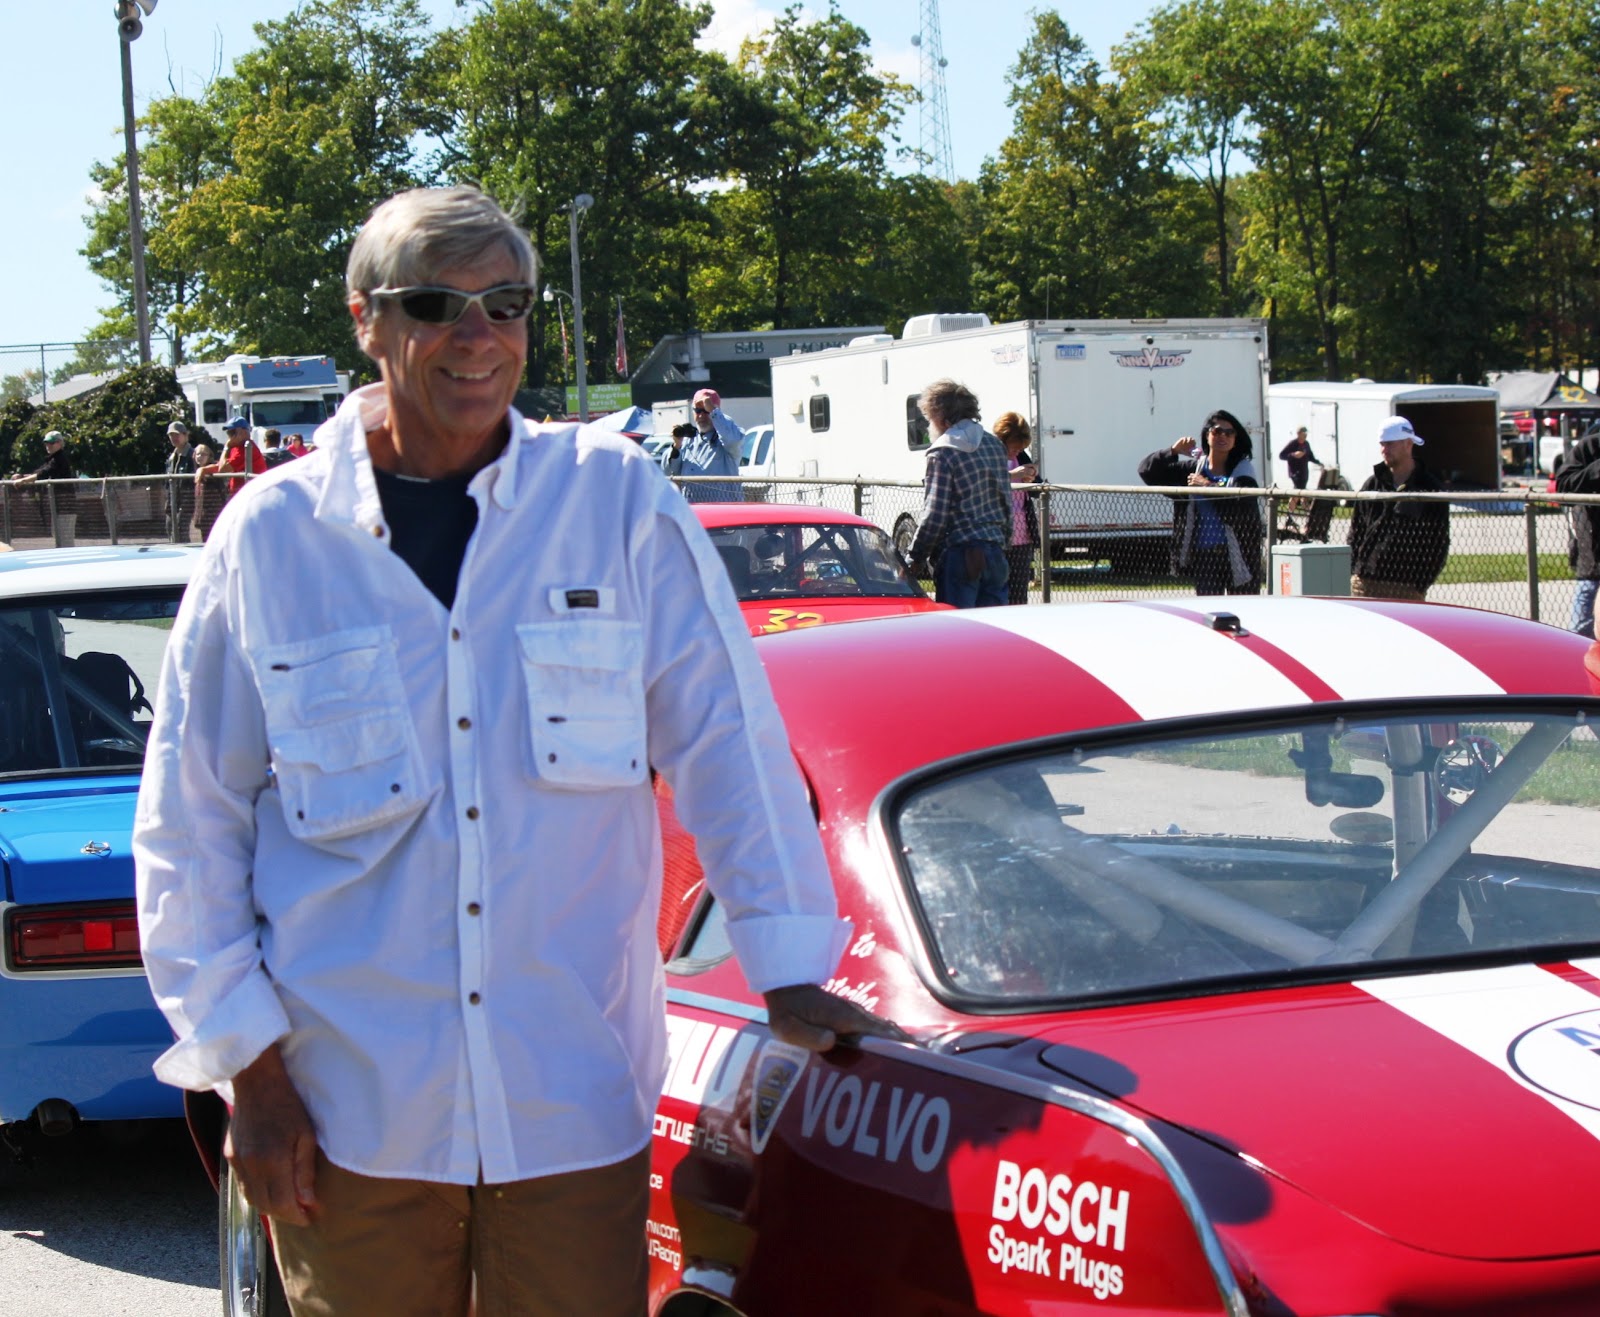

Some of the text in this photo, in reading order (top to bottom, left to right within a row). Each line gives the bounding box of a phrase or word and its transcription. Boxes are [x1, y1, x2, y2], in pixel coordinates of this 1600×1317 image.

[734, 341, 765, 354] SJB
[595, 385, 621, 393] John
[1556, 385, 1589, 403] 32
[850, 931, 876, 958] to
[801, 1065, 951, 1173] VOLVO
[991, 1160, 1130, 1252] BOSCH
[987, 1224, 1124, 1300] Spark Plugs
